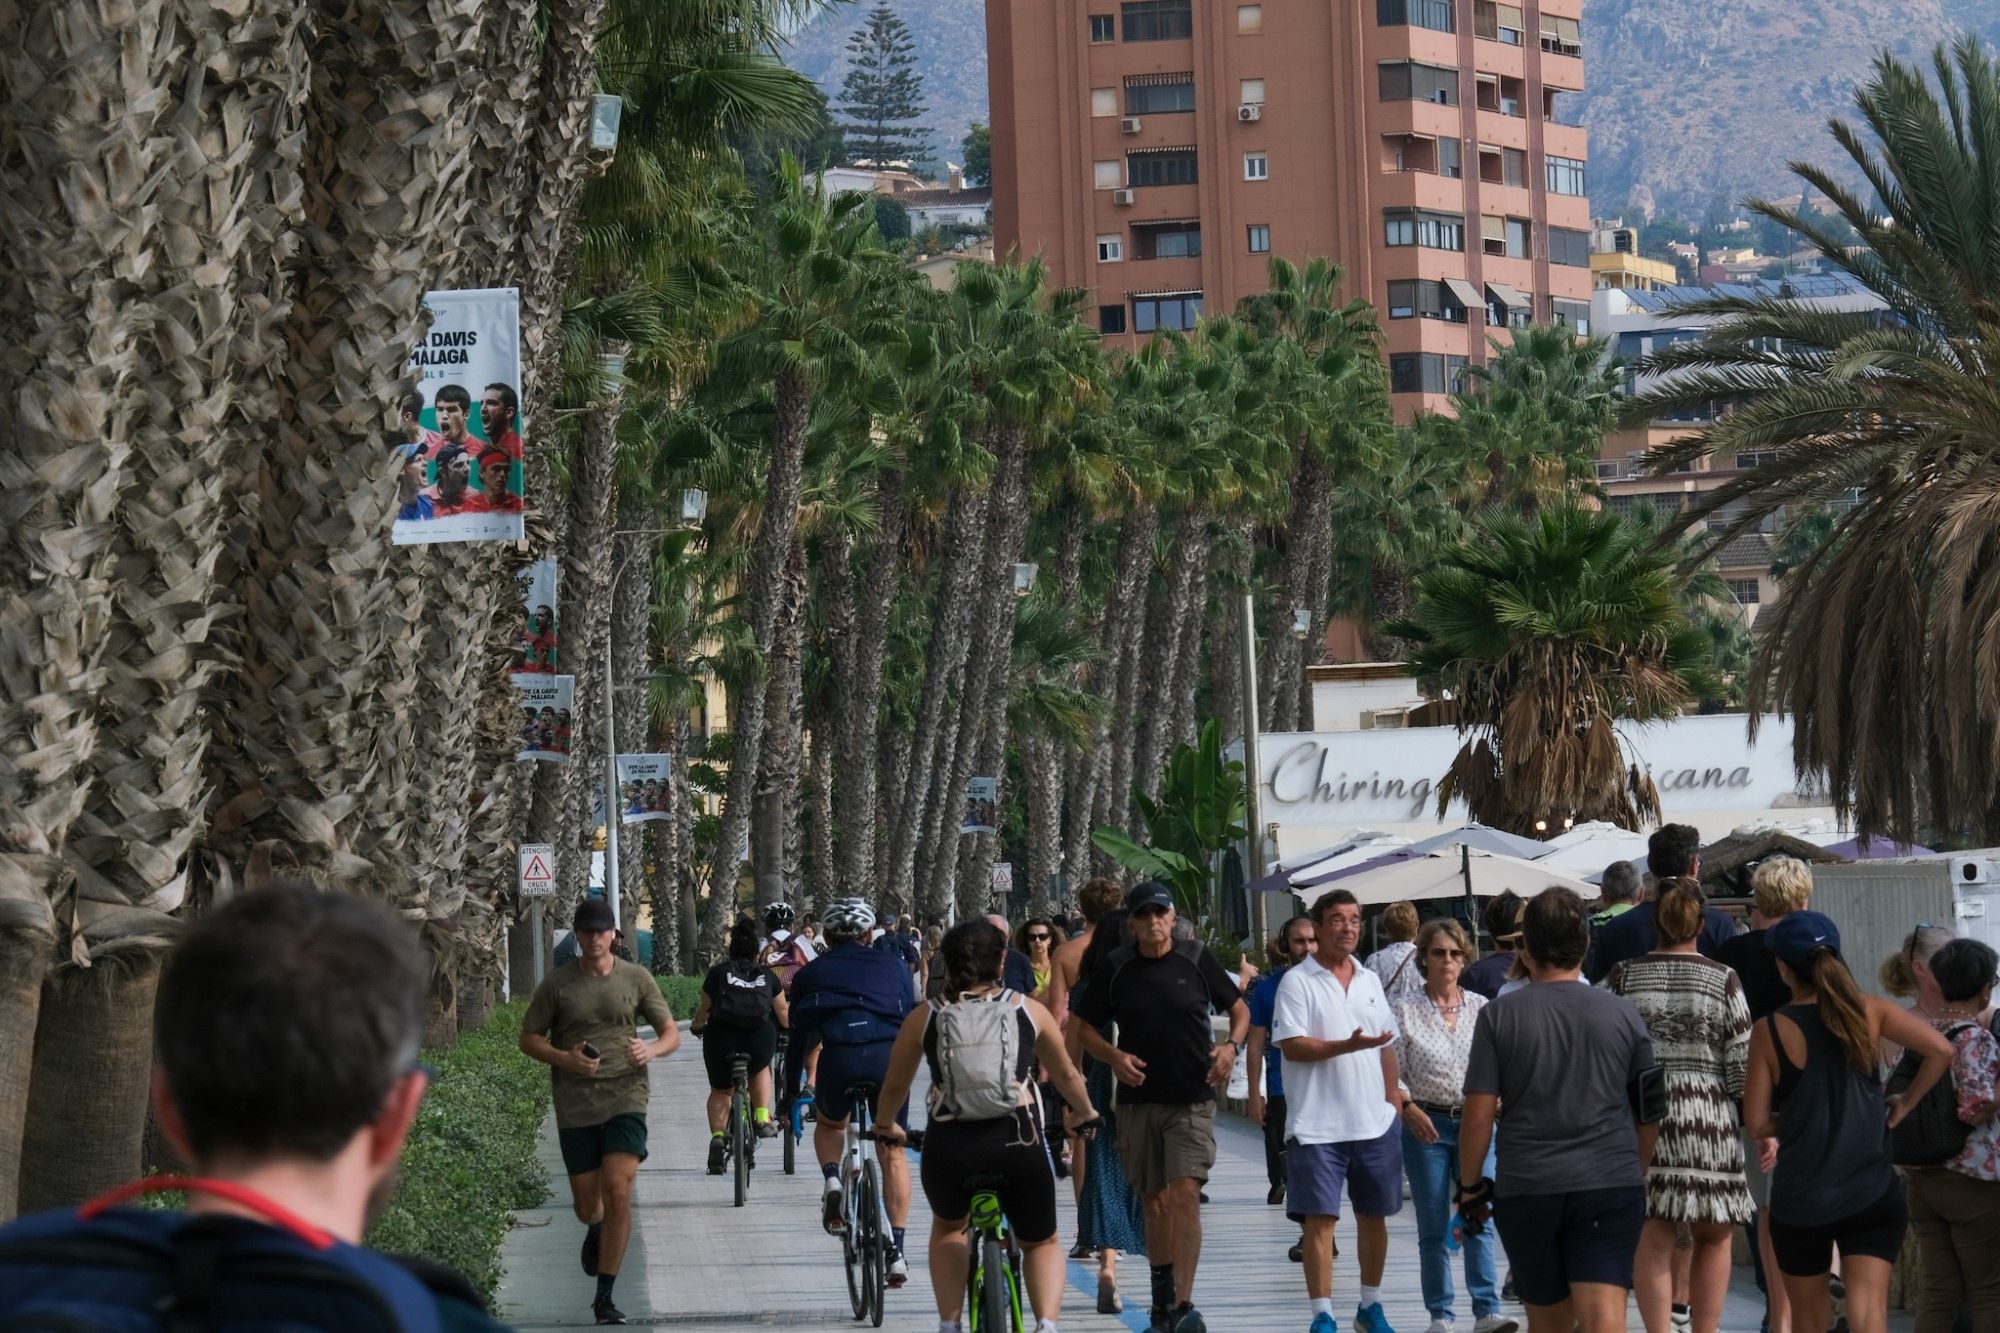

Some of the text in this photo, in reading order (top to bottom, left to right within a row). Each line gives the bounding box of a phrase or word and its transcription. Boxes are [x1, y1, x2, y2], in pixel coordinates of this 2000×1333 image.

[431, 331, 477, 347] DAVIS
[408, 348, 469, 366] MÁLAGA
[1265, 741, 1432, 818] Chiring
[726, 972, 766, 988] VANS
